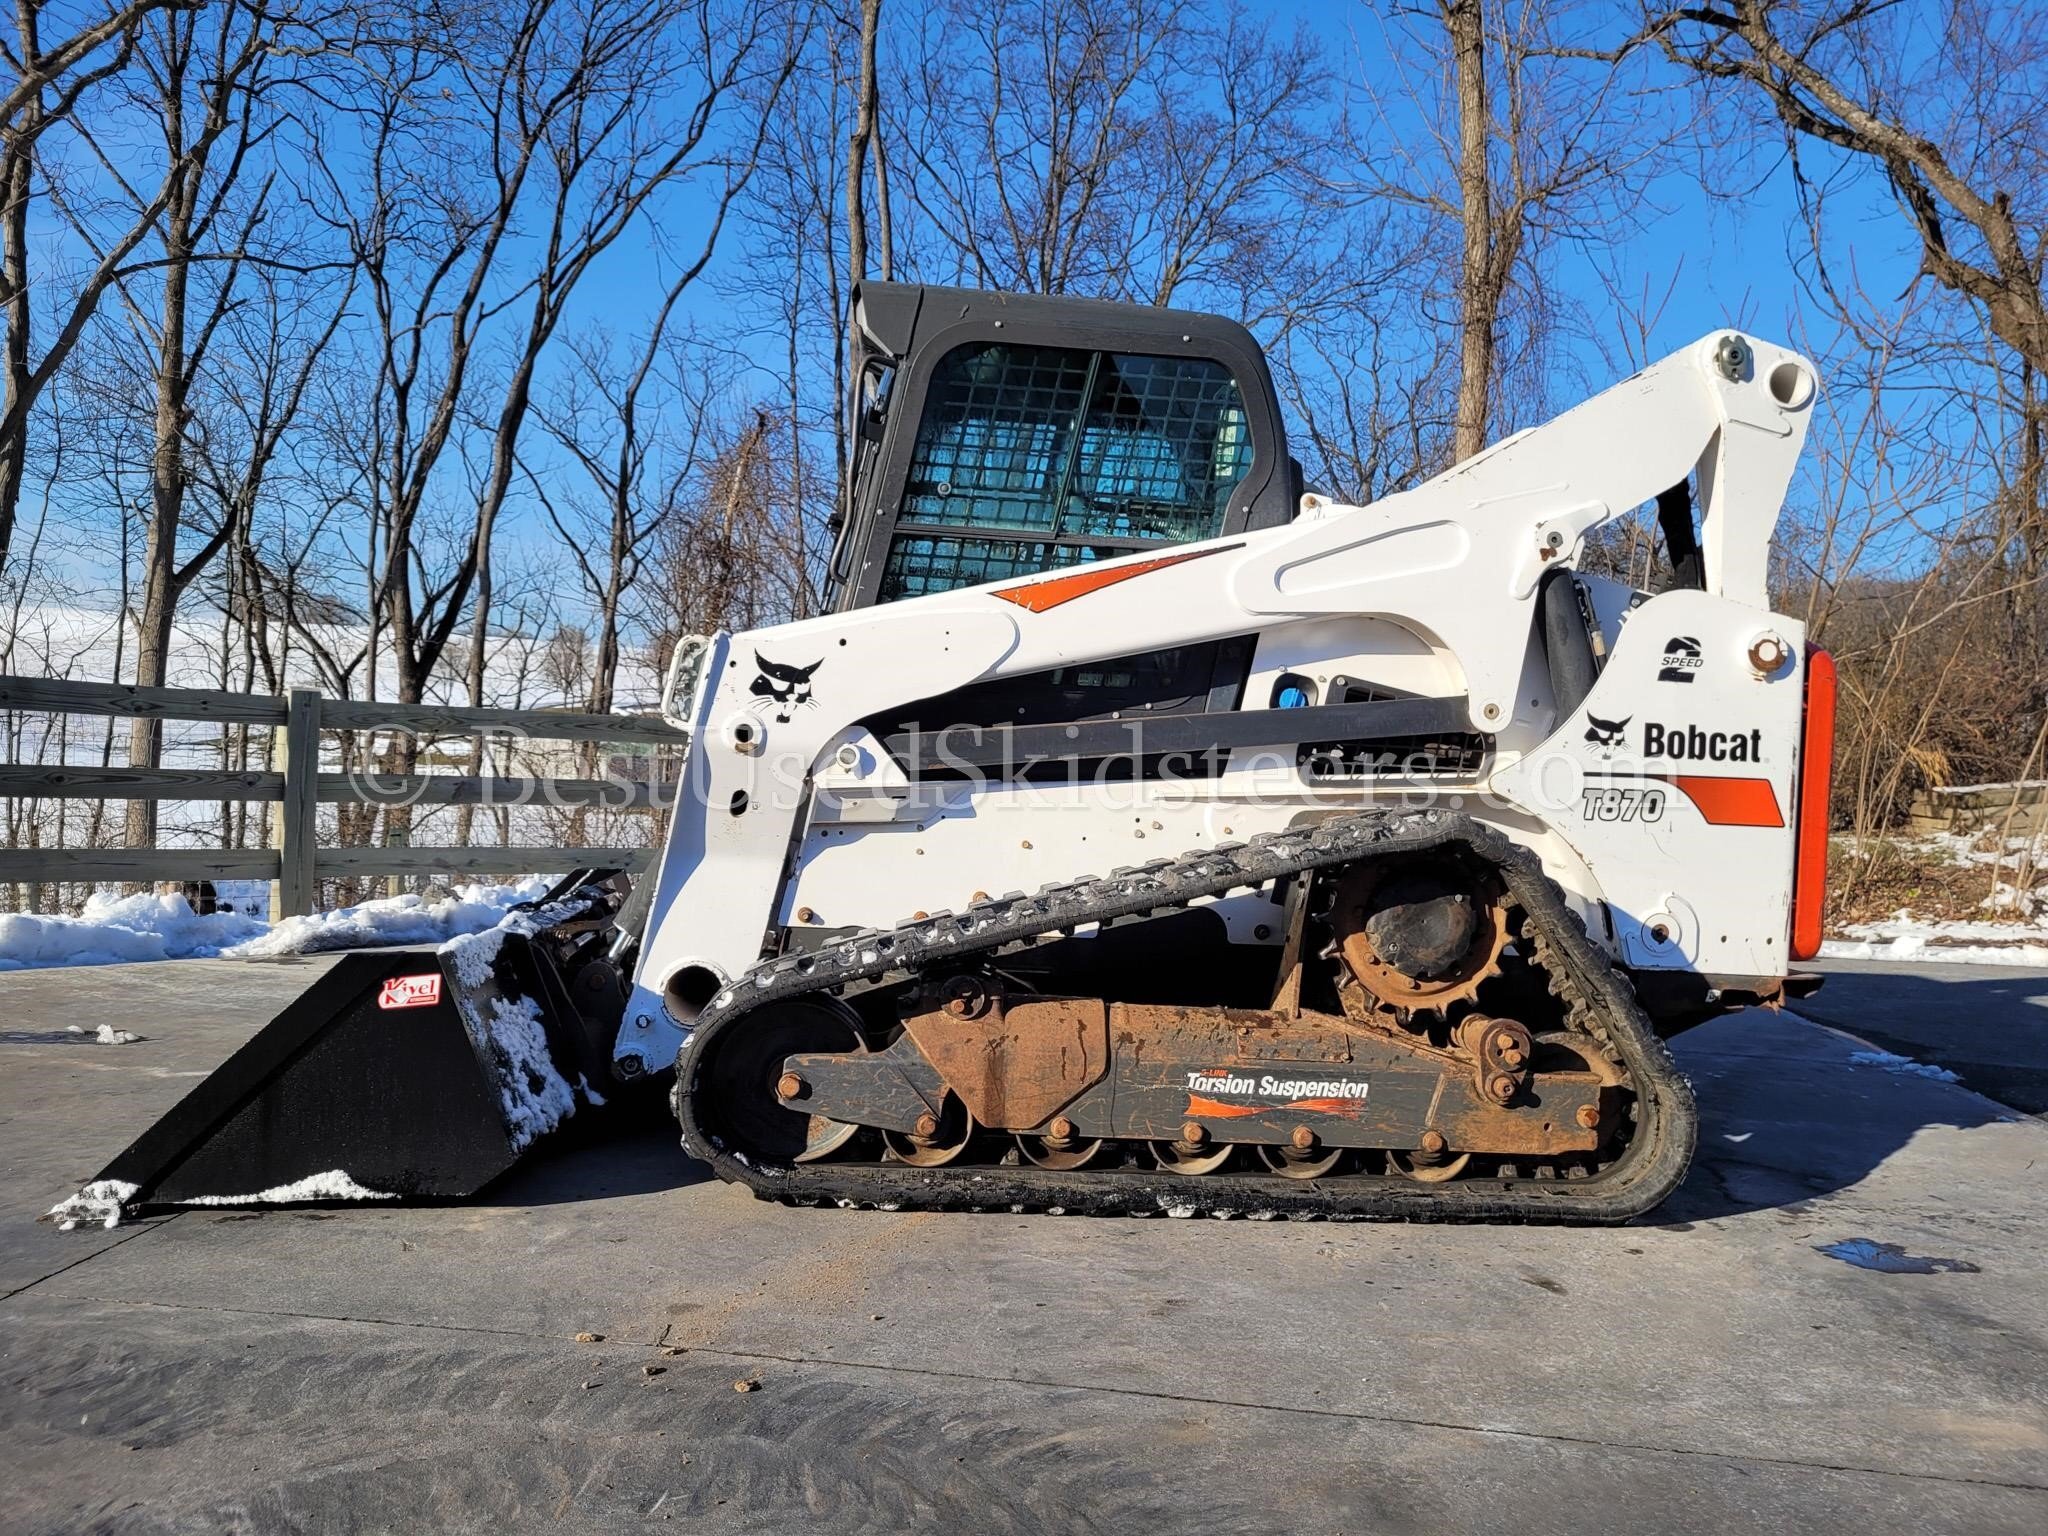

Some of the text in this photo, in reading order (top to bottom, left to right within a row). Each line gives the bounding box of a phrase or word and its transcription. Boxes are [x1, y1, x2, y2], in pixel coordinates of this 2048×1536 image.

[1661, 656, 1703, 668] SPEED
[1643, 722, 1761, 763] Bobcat
[1582, 787, 1666, 822] T870
[384, 979, 435, 1005] Kivel
[1187, 1072, 1369, 1100] Torsion Suspension
